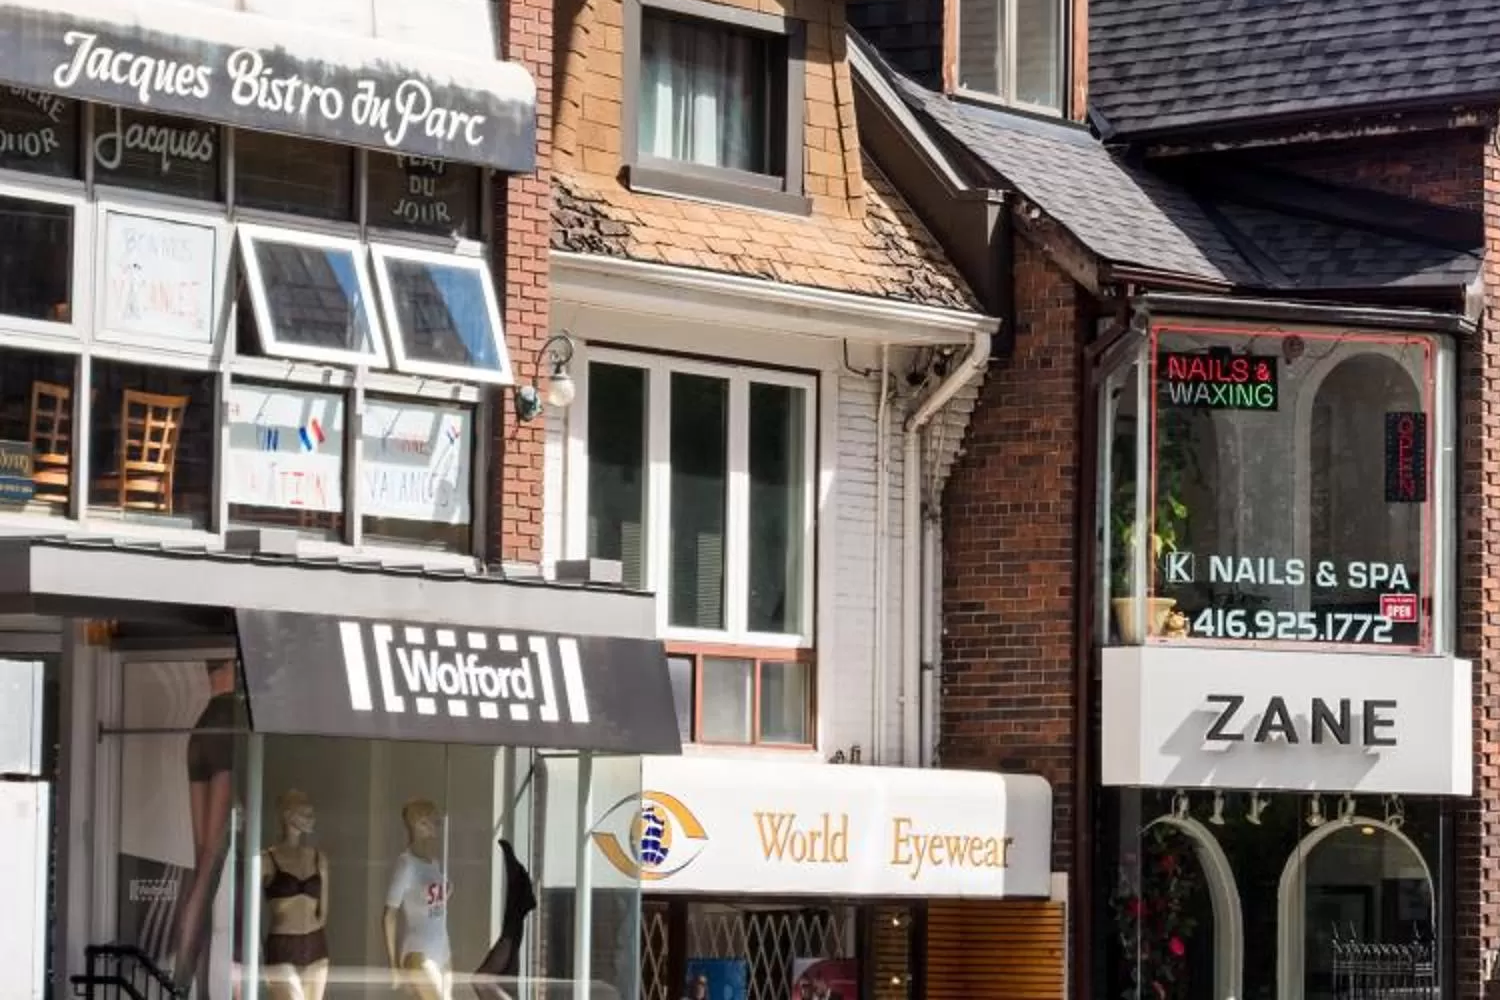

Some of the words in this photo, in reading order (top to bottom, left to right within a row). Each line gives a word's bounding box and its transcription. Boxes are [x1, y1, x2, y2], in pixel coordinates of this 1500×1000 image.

[53, 31, 212, 104] Jacques
[226, 48, 344, 119] Bistro
[351, 80, 390, 131] du
[384, 79, 486, 146] Parc
[408, 175, 435, 197] DU
[392, 199, 452, 224] JOUR
[1167, 356, 1249, 382] NAILS
[1255, 362, 1271, 382] &
[1168, 382, 1274, 407] WAXING
[1168, 553, 1191, 582] K
[1209, 556, 1305, 585] NAILS
[1315, 561, 1339, 587] &
[1348, 562, 1410, 589] SPA
[1193, 608, 1393, 643] 416.925.1772
[1385, 603, 1412, 618] OPEN
[396, 647, 535, 700] Wolford
[1206, 694, 1397, 746] ZANE
[753, 810, 849, 863] World
[890, 816, 1015, 880] Eyewear
